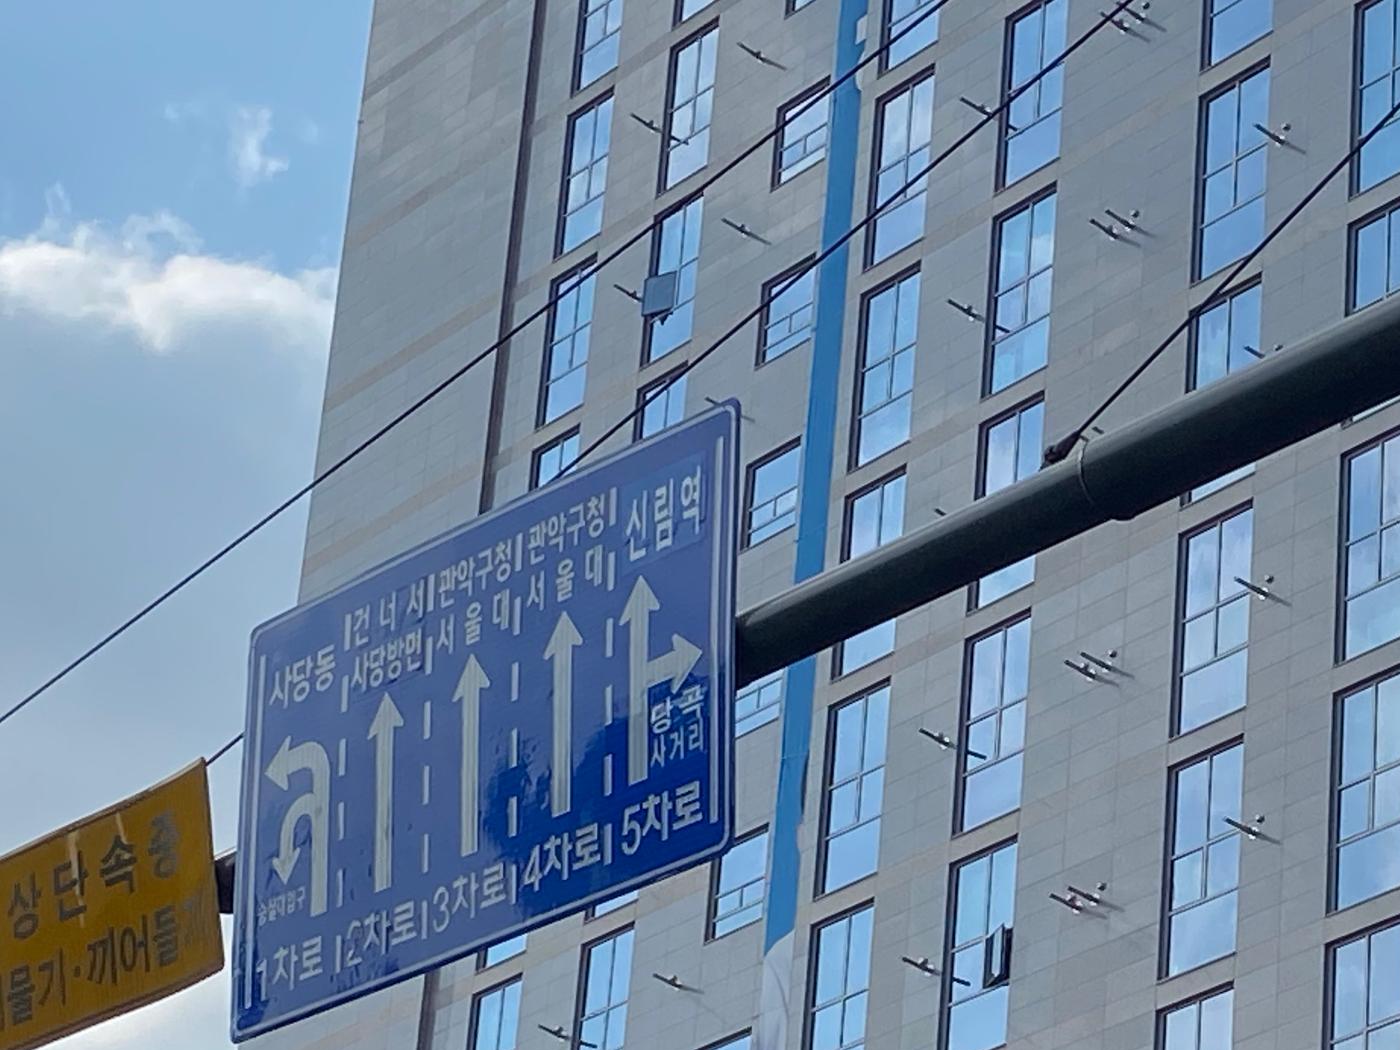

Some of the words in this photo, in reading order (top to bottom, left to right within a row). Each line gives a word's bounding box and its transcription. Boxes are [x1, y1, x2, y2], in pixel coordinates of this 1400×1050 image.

[528, 493, 605, 566] 관악구청
[625, 464, 702, 562] 신림역
[438, 538, 512, 608] 관악구청
[526, 544, 603, 612] 서울대
[353, 579, 425, 652] 건너서
[436, 588, 510, 655] 서울대
[270, 645, 337, 709] 사당동
[351, 628, 422, 692] 사당방면
[650, 684, 707, 734] 당곡
[650, 717, 705, 768] 사거리
[621, 780, 703, 856] 5차로
[521, 822, 601, 892] 4차로
[432, 861, 507, 933] 3차로
[256, 935, 323, 1001] 1차로
[346, 899, 417, 968] 2차로
